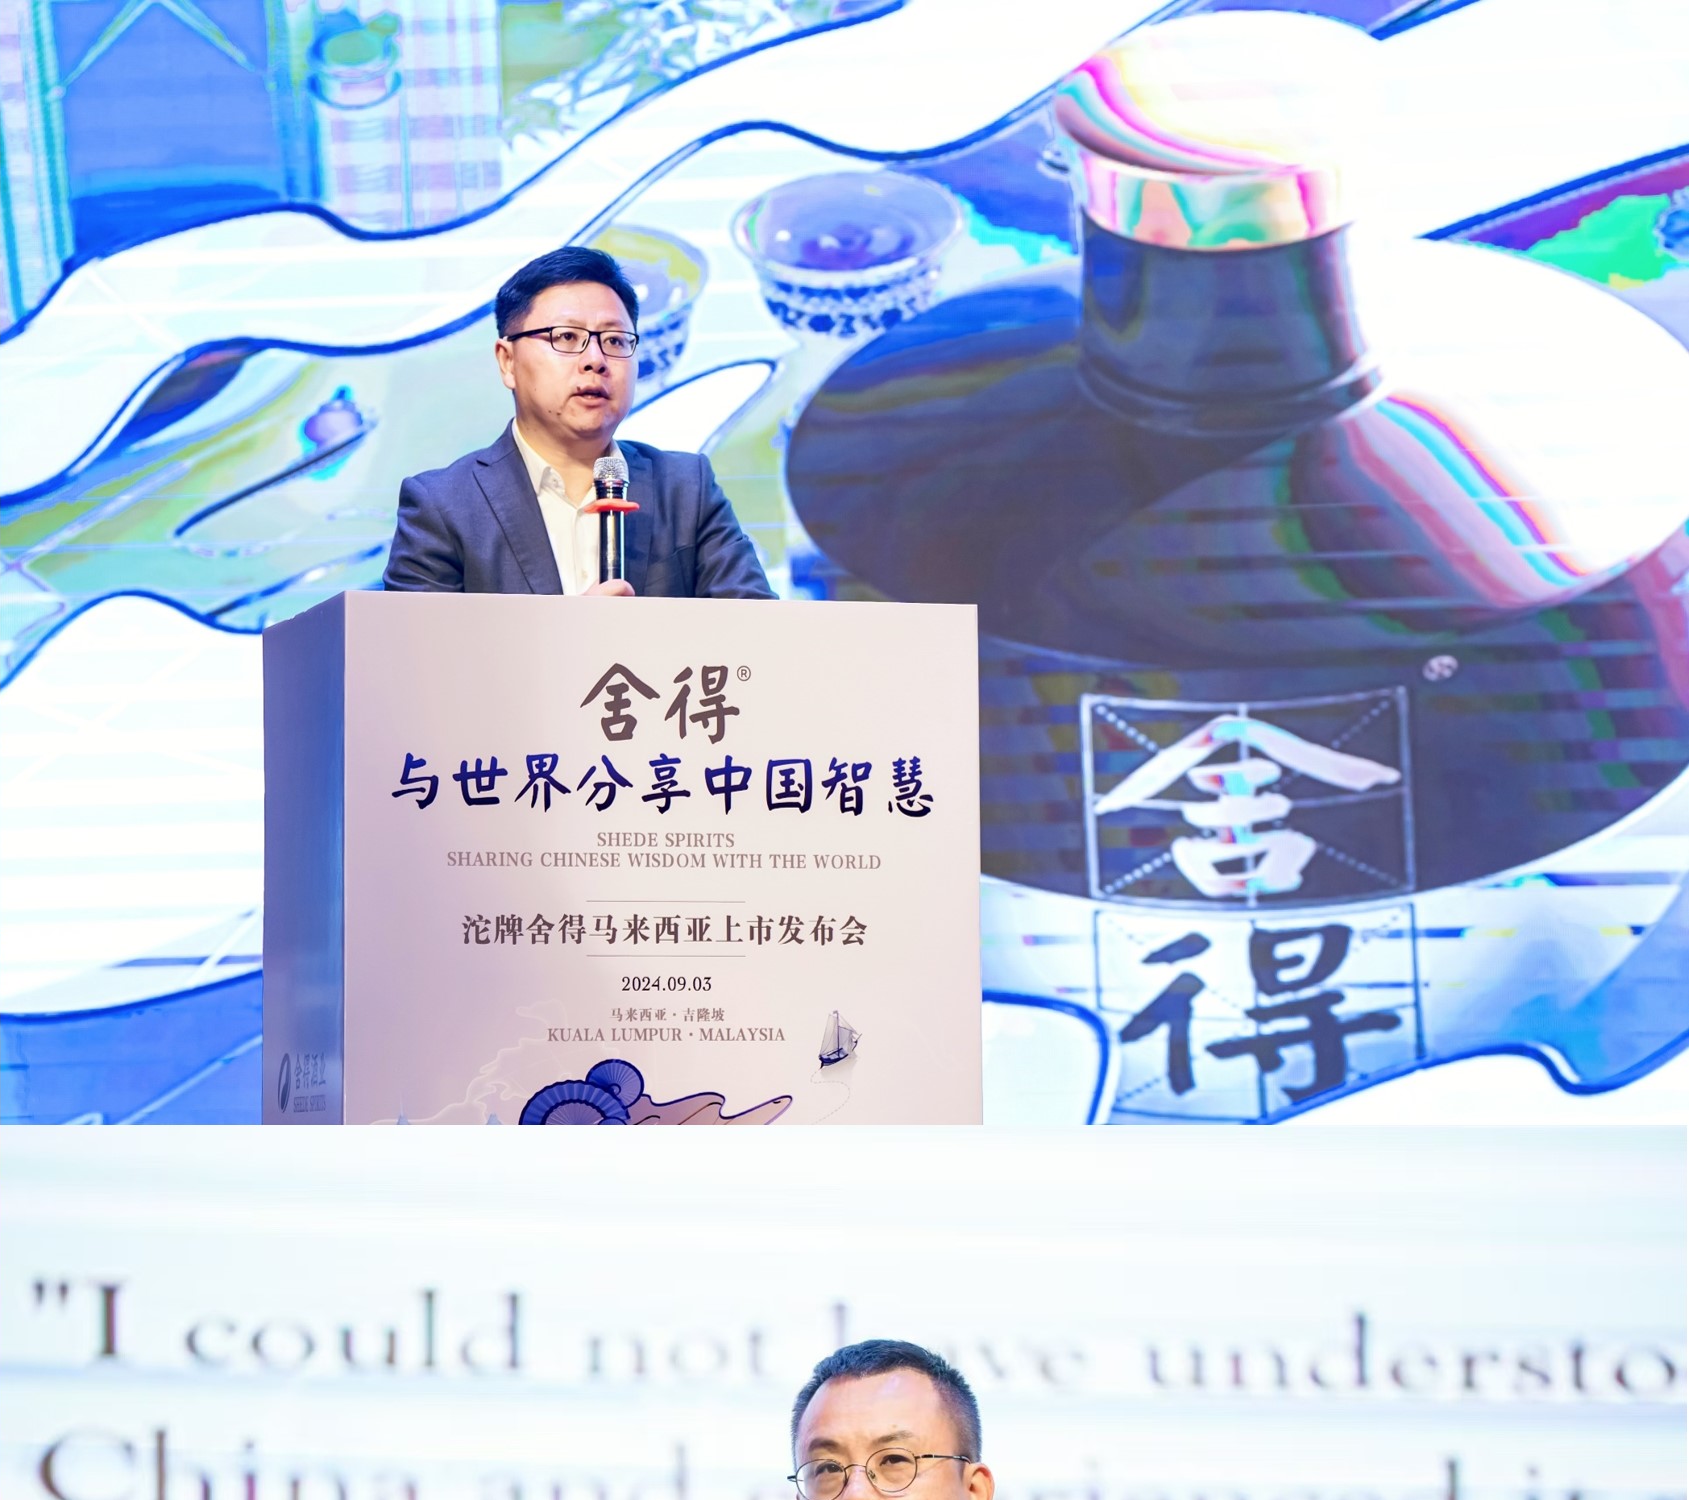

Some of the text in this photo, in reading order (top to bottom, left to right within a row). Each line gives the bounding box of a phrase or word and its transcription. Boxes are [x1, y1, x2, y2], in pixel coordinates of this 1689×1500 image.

[391, 753, 934, 818] 与世界分享中国智慧
[597, 831, 736, 849] SHEDE SPIRITS
[447, 851, 882, 870] SHARING CHINESE WISDOM WITH THE WORLD
[461, 913, 869, 947] 沱牌舍得马来西亚上市发布会
[621, 975, 713, 992] 2024.09.03
[547, 1027, 786, 1043] KUALA LUMPUR MALAYSIA
[184, 1288, 525, 1373] could
[585, 1325, 777, 1382] not
